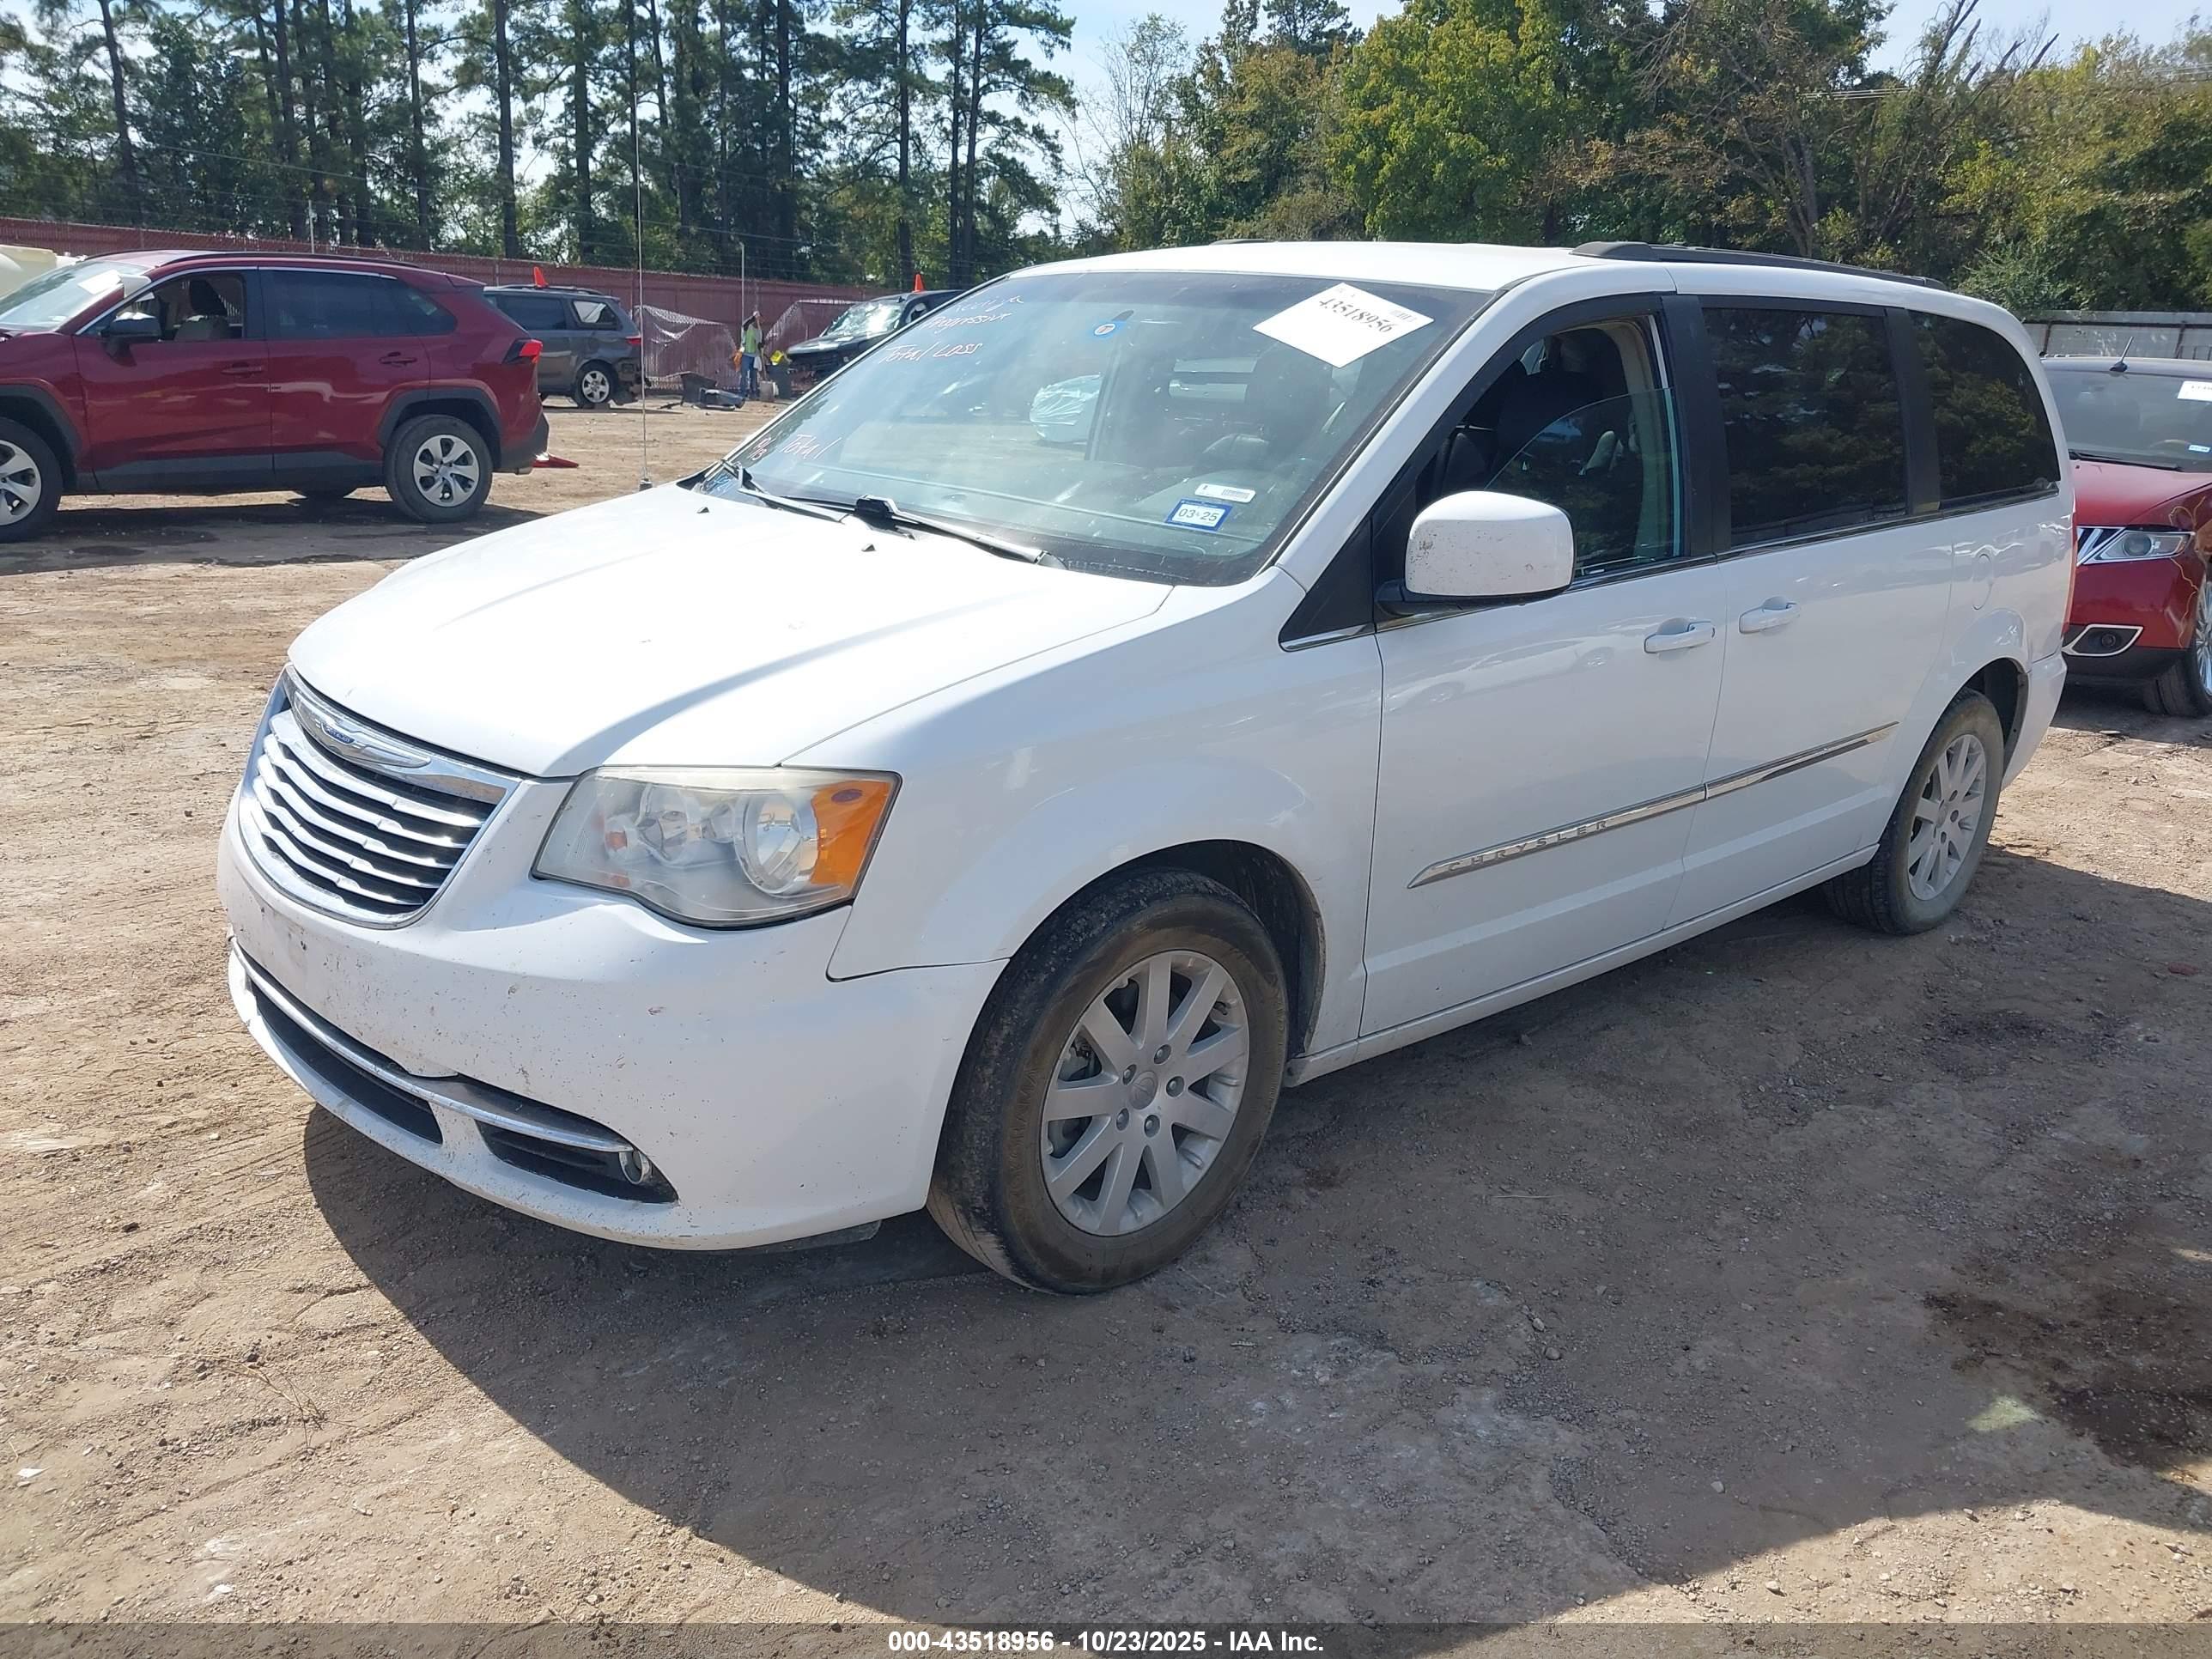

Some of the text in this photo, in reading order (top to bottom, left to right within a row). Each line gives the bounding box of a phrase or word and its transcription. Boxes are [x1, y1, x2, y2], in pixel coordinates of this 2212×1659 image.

[1318, 298, 1396, 333] 43518956
[1177, 508, 1220, 522] 03 25
[1448, 820, 1608, 872] CHRYSLER
